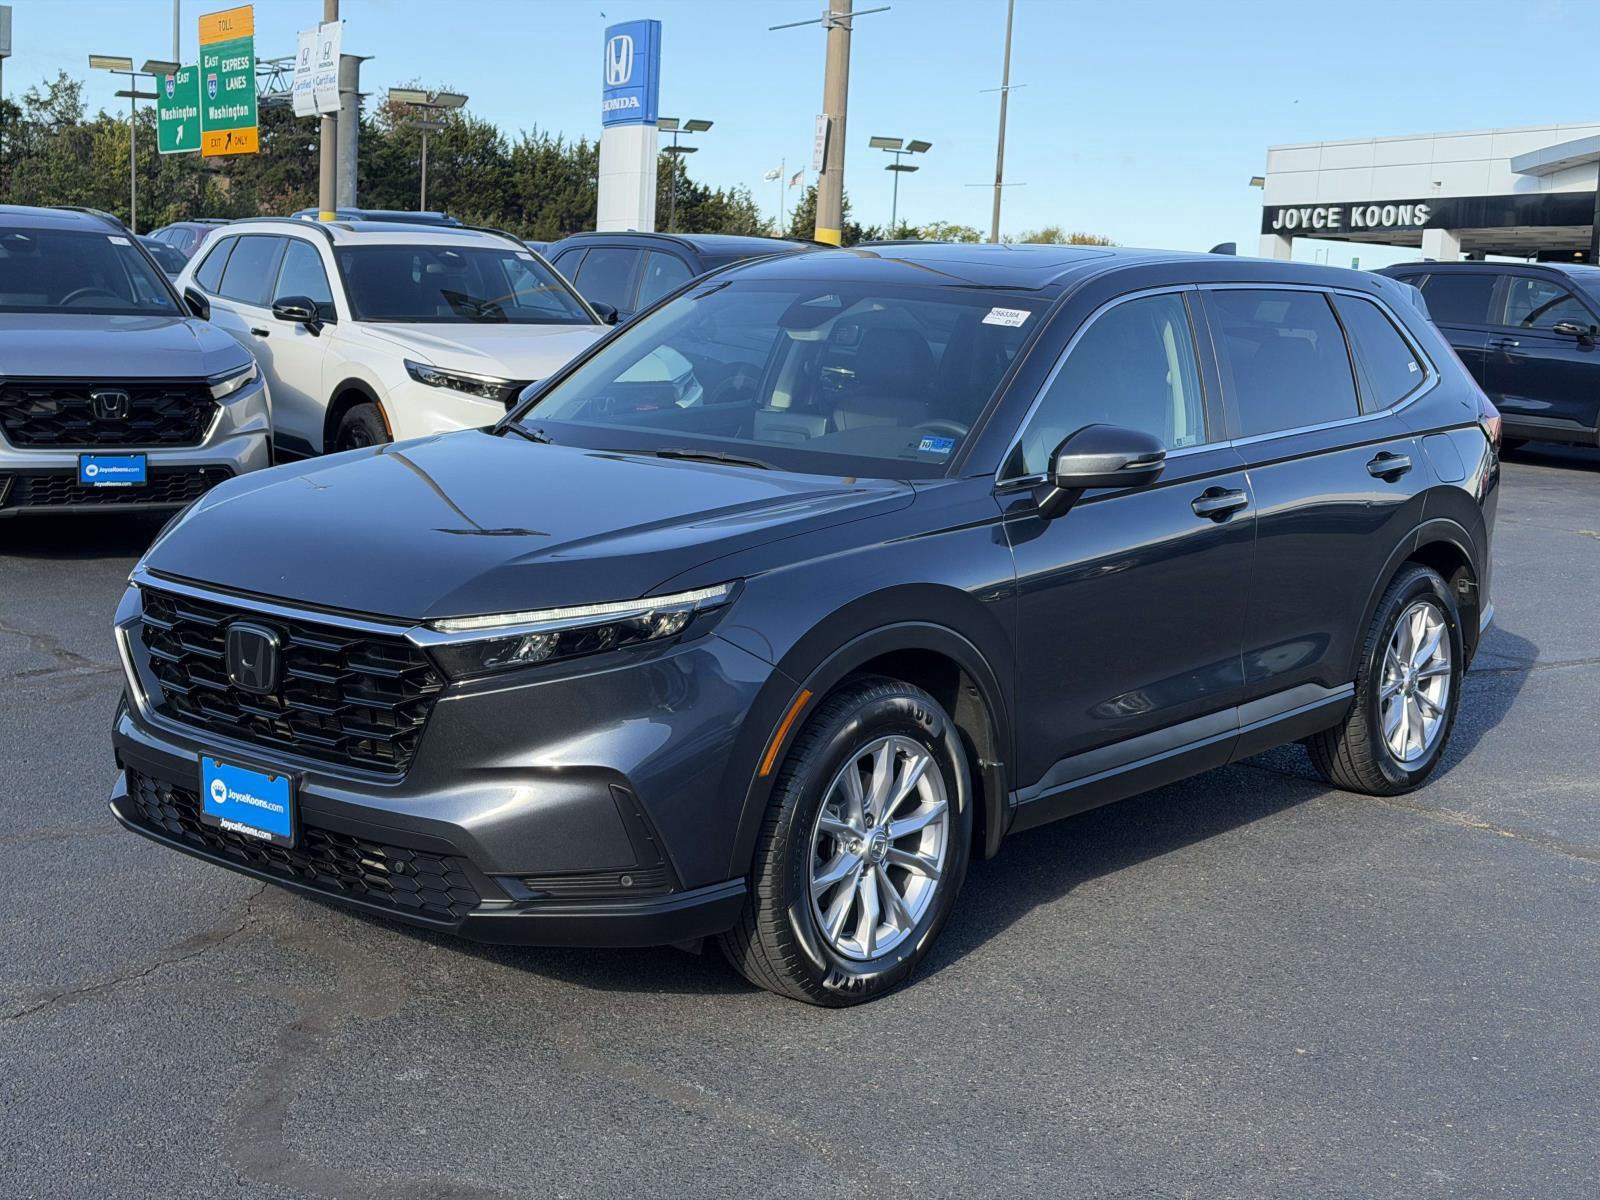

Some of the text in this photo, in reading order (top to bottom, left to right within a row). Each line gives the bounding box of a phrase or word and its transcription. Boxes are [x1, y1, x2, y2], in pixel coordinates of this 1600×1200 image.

[218, 19, 233, 32] TOLL
[222, 56, 250, 73] EXPRESS
[225, 76, 247, 91] LANES
[160, 106, 197, 121] Washington
[208, 104, 249, 121] Washington
[211, 136, 248, 148] EXIT ONLY
[1272, 204, 1431, 229] JOYCE KOONS
[228, 788, 284, 814] JoyceKoons.com
[220, 818, 272, 840] JoyceKoons.com
